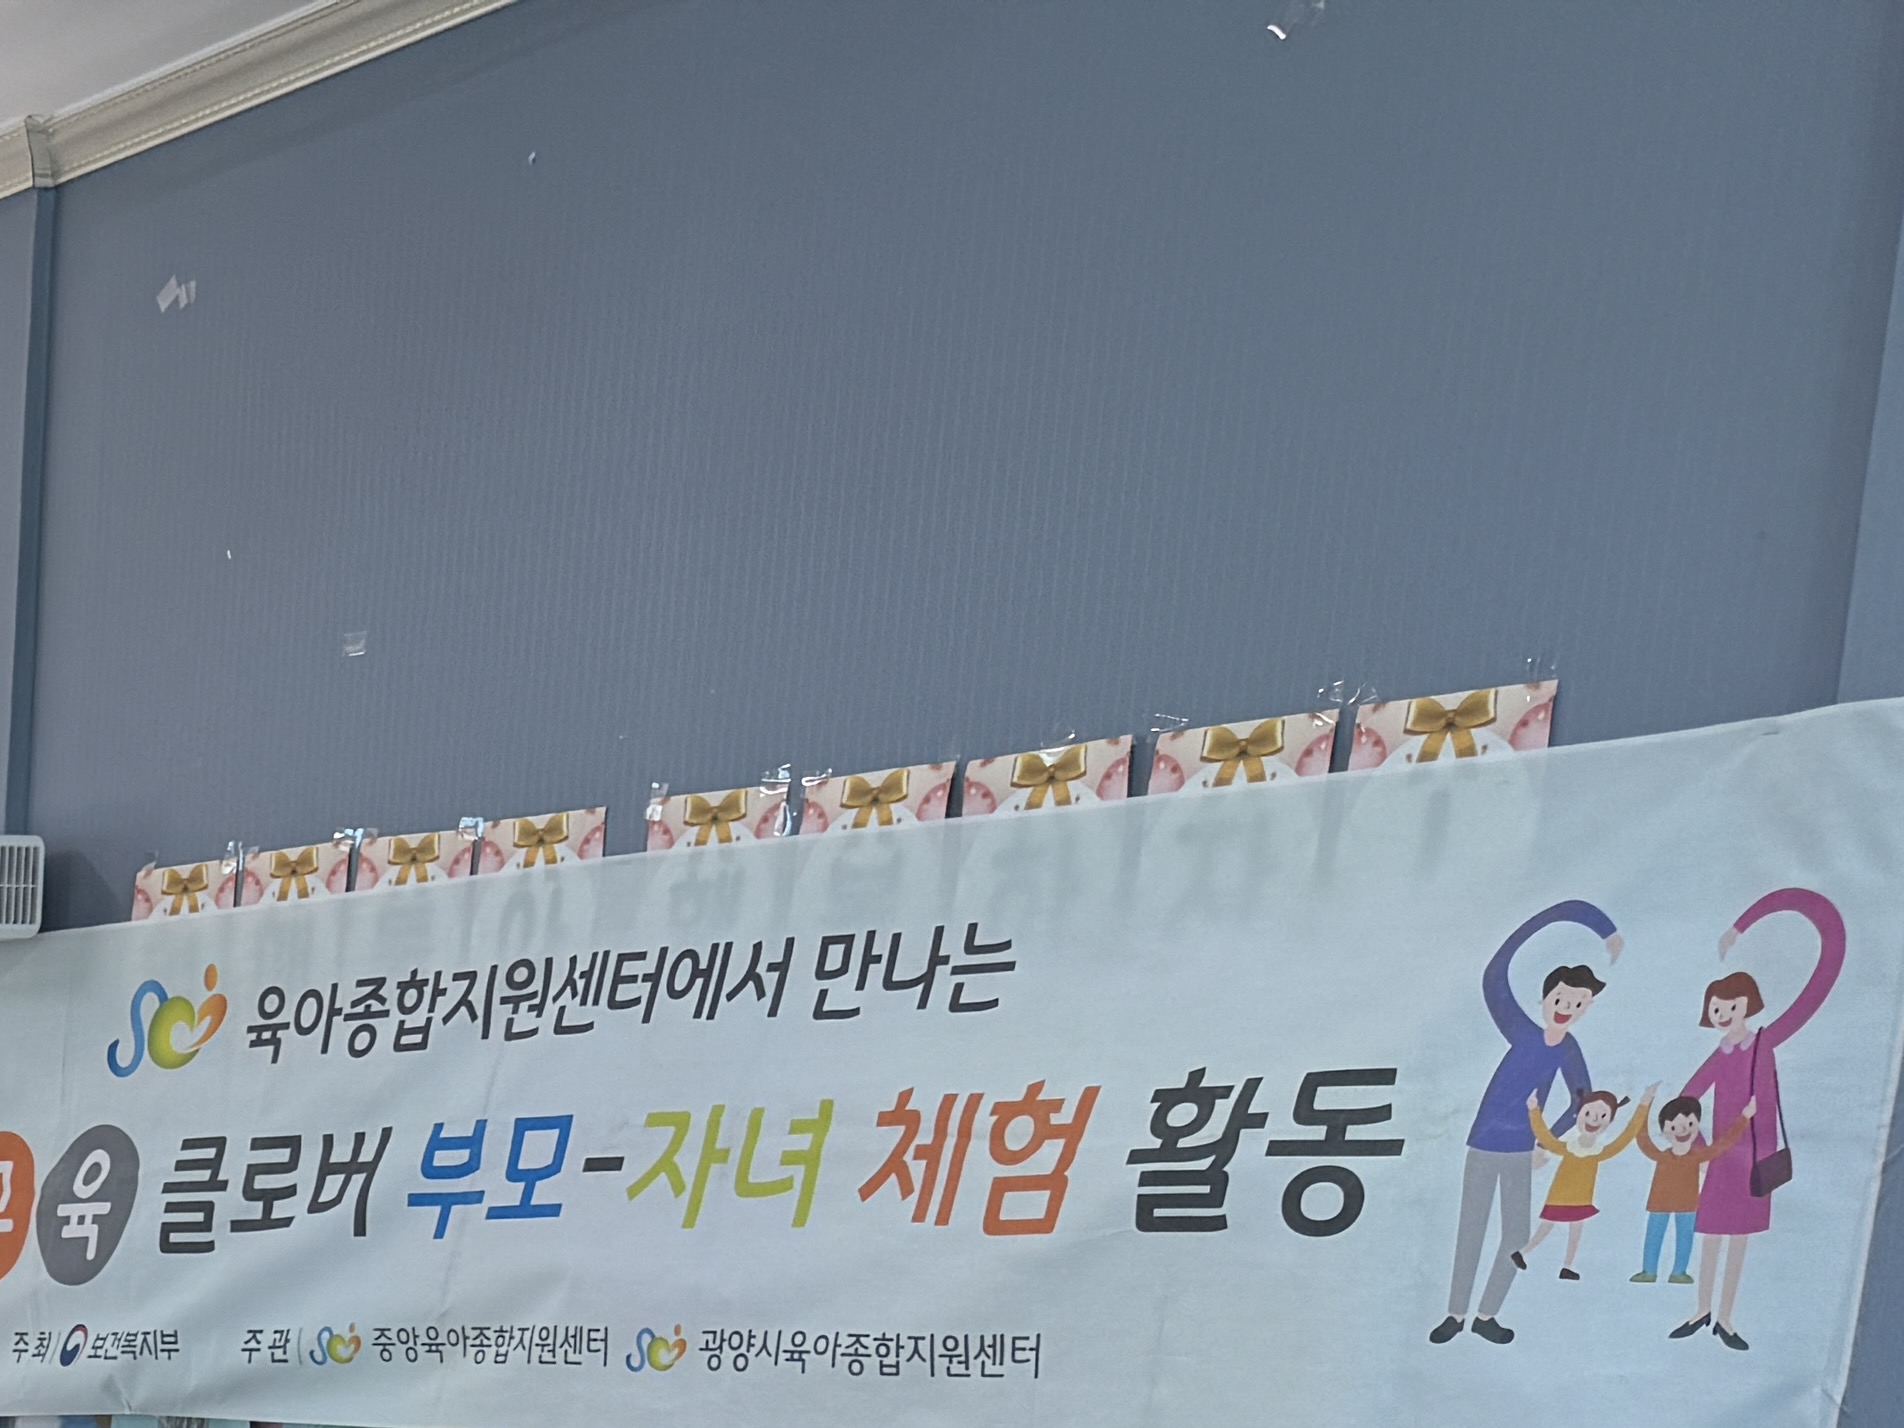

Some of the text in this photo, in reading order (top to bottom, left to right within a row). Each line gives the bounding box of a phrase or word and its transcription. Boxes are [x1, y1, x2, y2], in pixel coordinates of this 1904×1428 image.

[245, 921, 1018, 1066] 육아종합지원센터에서 만나는
[159, 1125, 394, 1255] 클로버
[406, 1098, 836, 1242] 부모-자녀
[858, 1078, 1103, 1237] 체험
[1125, 1066, 1406, 1238] 활동
[87, 1329, 181, 1362] 보건복지부
[372, 1323, 609, 1367] 중앙육아종합지원센터
[698, 1327, 1042, 1379] 광양시육아종합지원센터
